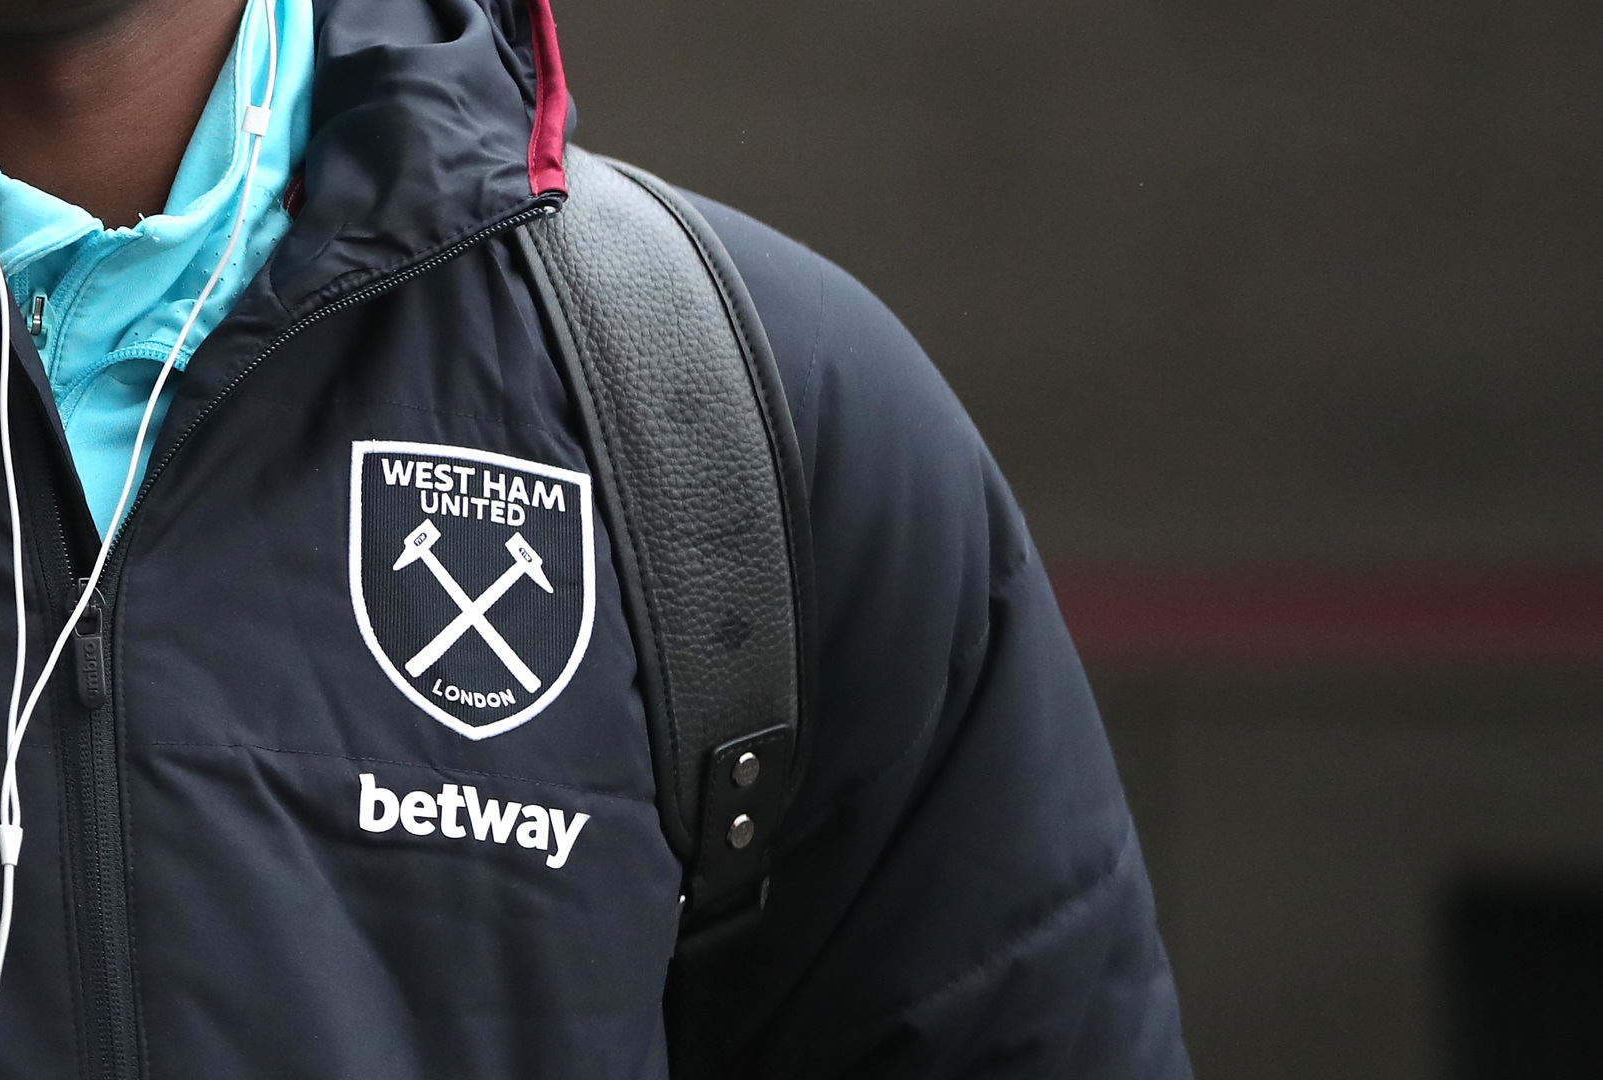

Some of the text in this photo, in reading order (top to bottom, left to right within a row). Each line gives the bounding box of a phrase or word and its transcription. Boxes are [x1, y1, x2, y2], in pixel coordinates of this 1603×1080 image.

[382, 458, 566, 512] WEST HAM
[420, 490, 525, 526] UNITED
[432, 678, 516, 708] LONDON
[358, 773, 591, 869] betway
